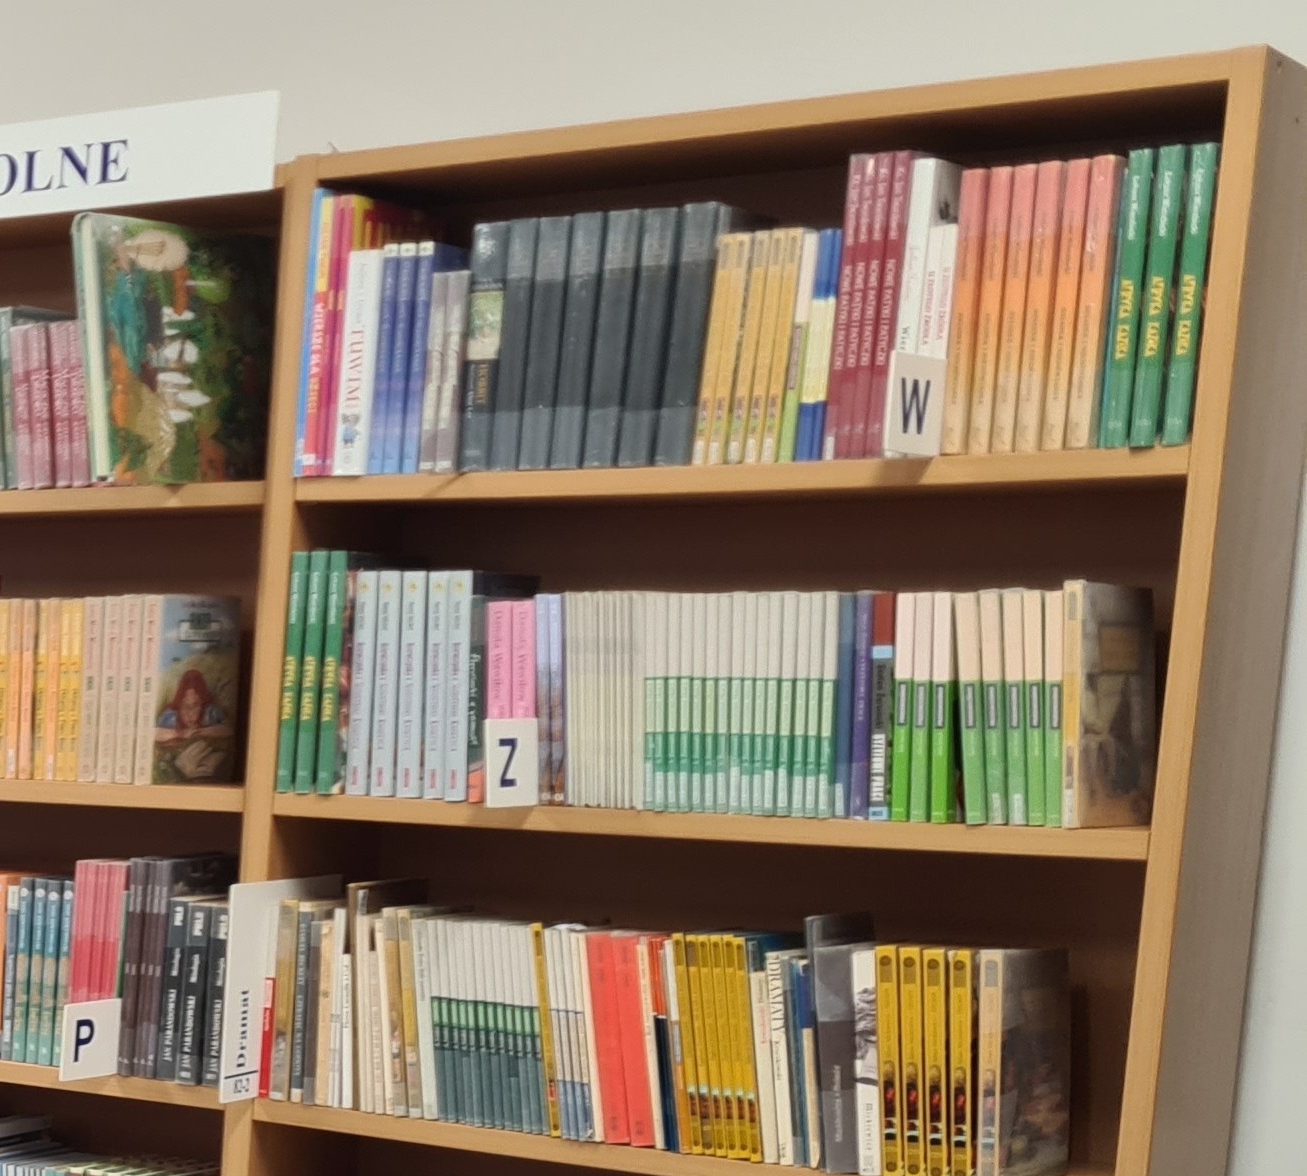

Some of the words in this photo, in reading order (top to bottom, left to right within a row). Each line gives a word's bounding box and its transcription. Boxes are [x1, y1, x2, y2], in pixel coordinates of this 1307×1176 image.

[901, 377, 931, 435] W
[498, 737, 518, 788] Z
[73, 1018, 95, 1063] P
[236, 990, 249, 1068] Dramat
